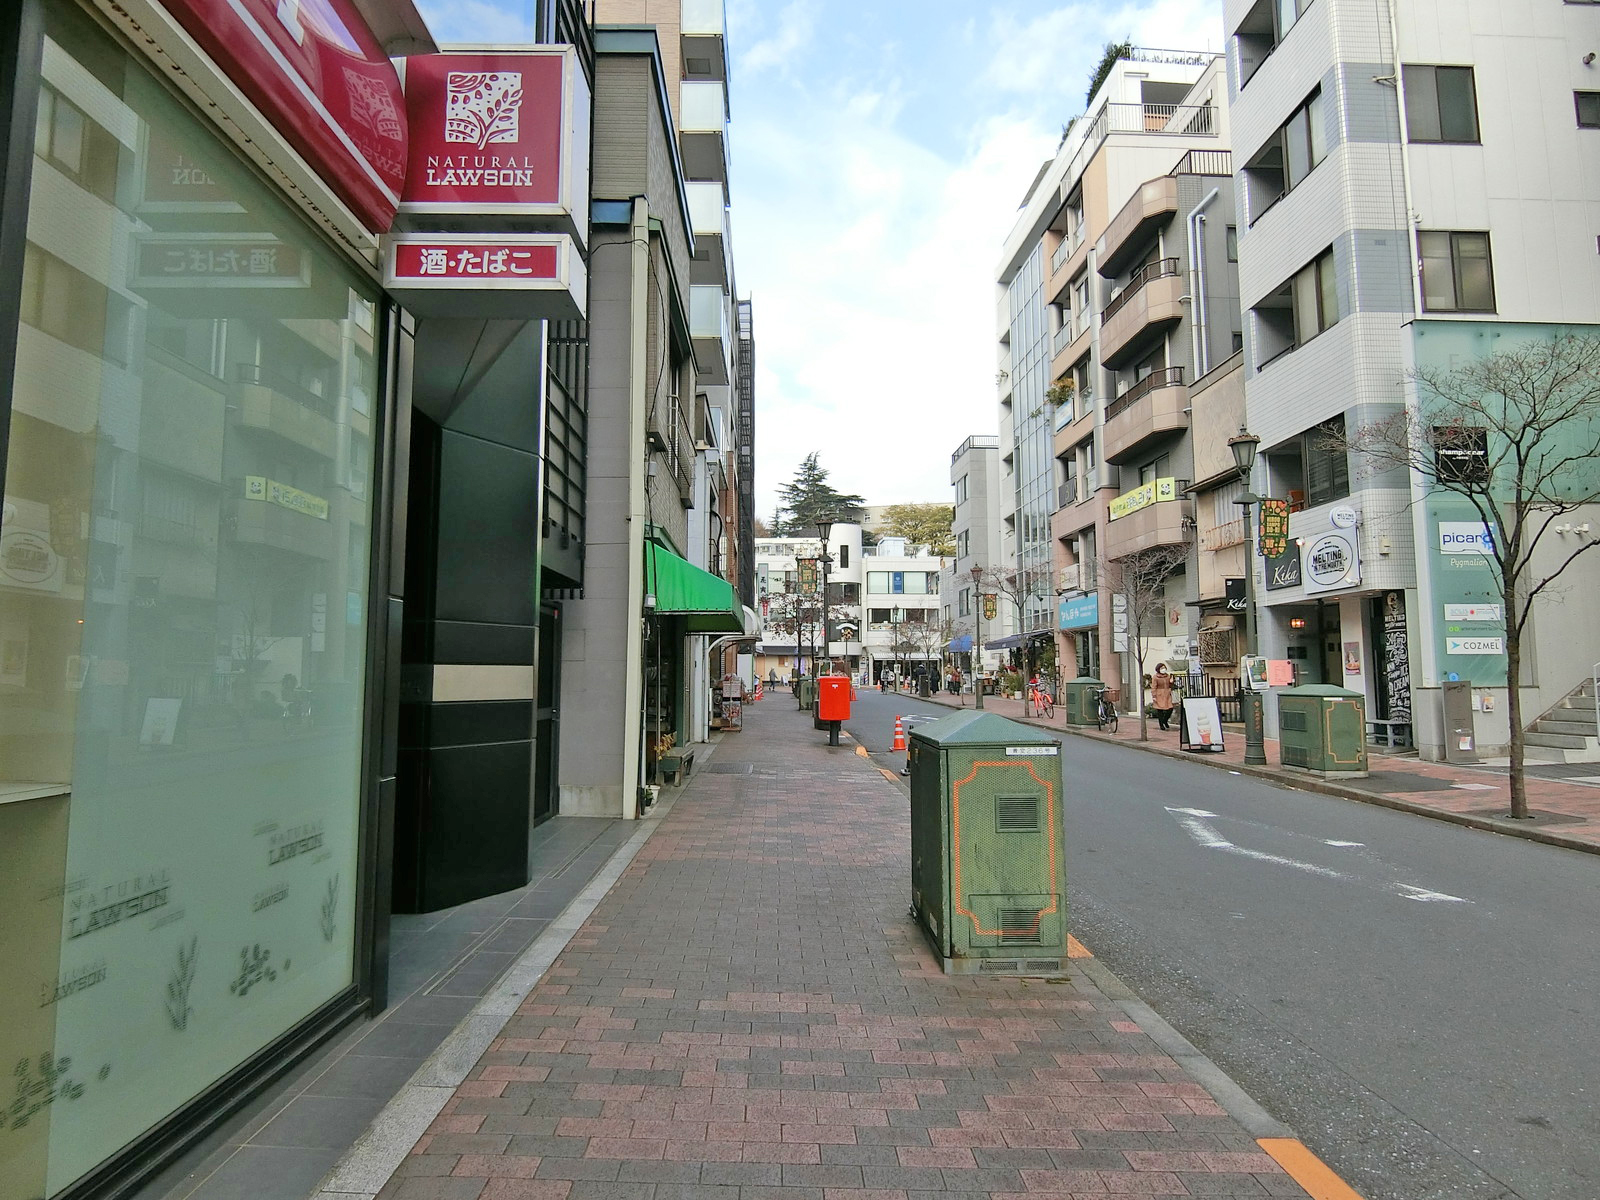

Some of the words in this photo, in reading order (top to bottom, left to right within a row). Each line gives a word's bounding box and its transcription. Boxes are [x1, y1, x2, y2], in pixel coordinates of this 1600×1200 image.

[428, 156, 534, 168] NATURAL
[427, 170, 533, 186] LAWSON
[1312, 549, 1342, 564] MELTING
[1272, 558, 1298, 586] Kika
[1463, 641, 1500, 650] COZMEL
[68, 886, 172, 940] LAWSON
